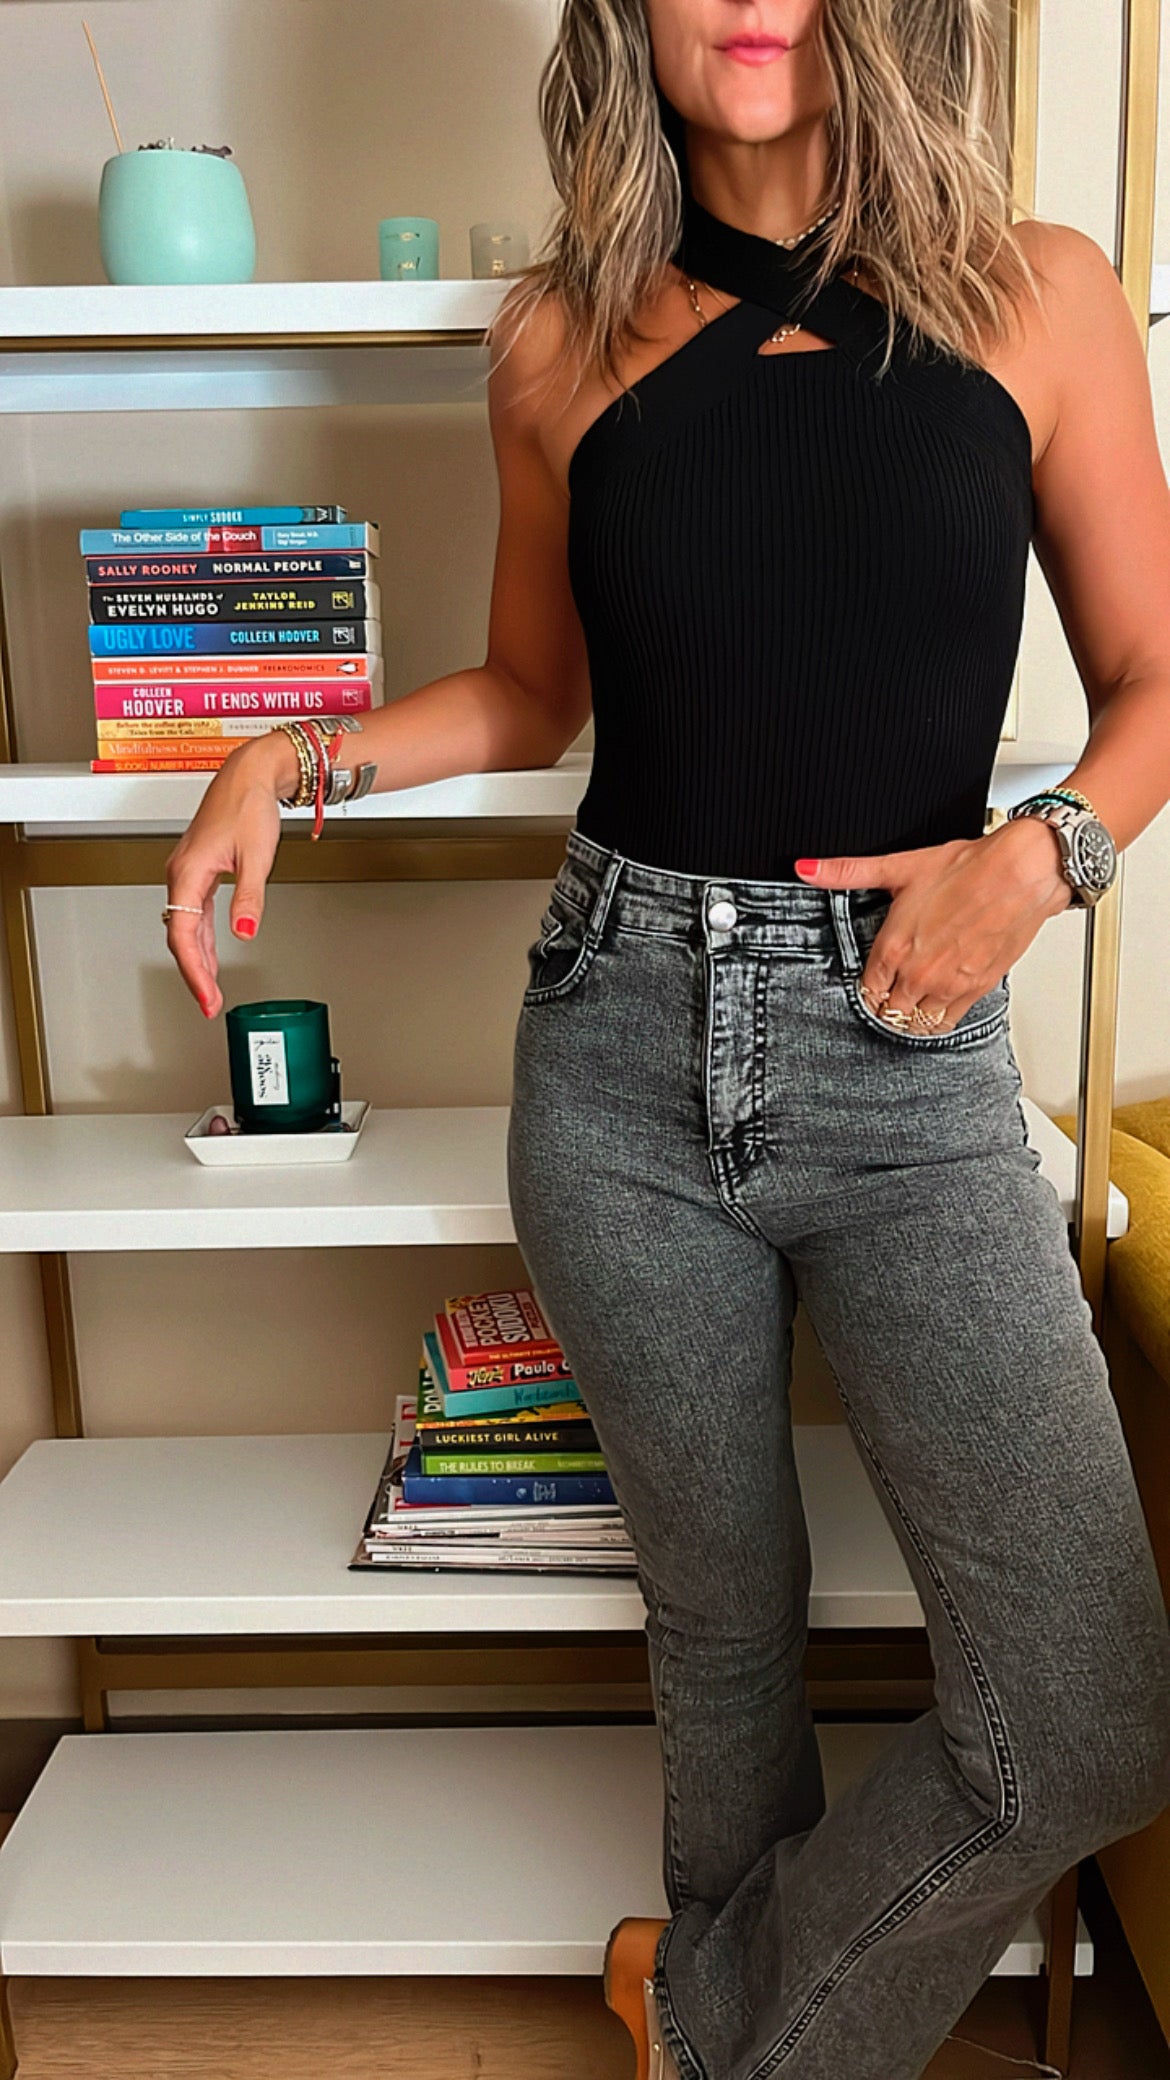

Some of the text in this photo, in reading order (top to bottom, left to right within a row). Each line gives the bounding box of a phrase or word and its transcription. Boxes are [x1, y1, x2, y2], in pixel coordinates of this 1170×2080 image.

[210, 511, 243, 523] SUDOKU
[112, 532, 131, 543] The
[133, 532, 162, 543] Other
[165, 531, 189, 542] Side
[190, 531, 202, 541] of
[204, 530, 220, 541] the
[98, 563, 198, 577] SALLY ROONEY
[212, 560, 323, 574] NORMAL PEOPLE
[115, 594, 152, 602] SEVEN
[155, 592, 214, 602] HUSBANDS
[252, 591, 297, 601] TAYLOR
[107, 602, 219, 617] EVELYN HUGO
[234, 600, 316, 611] JENKINS REID
[103, 626, 196, 650] UGLY LOVE
[230, 631, 276, 644] COLLEEN
[278, 630, 320, 643] HOOVER
[108, 667, 137, 675] STEVEN
[148, 666, 173, 674] LEVITT
[183, 665, 217, 674] STEPHEN
[262, 663, 325, 672] FREAKONOMICS
[132, 687, 173, 698] COLLEEN
[203, 692, 218, 710] IT
[221, 692, 260, 710] ENDS
[262, 691, 300, 709] WITH
[303, 690, 324, 708] US
[122, 699, 185, 717] HOOVER
[108, 742, 178, 755] Mindfulness
[487, 1292, 530, 1343] SUDOKU
[514, 1360, 556, 1377] Paulo
[435, 1432, 559, 1444] LUCKIEST GIRL ALIVE
[439, 1459, 536, 1473] THE RULES TO BREAK
